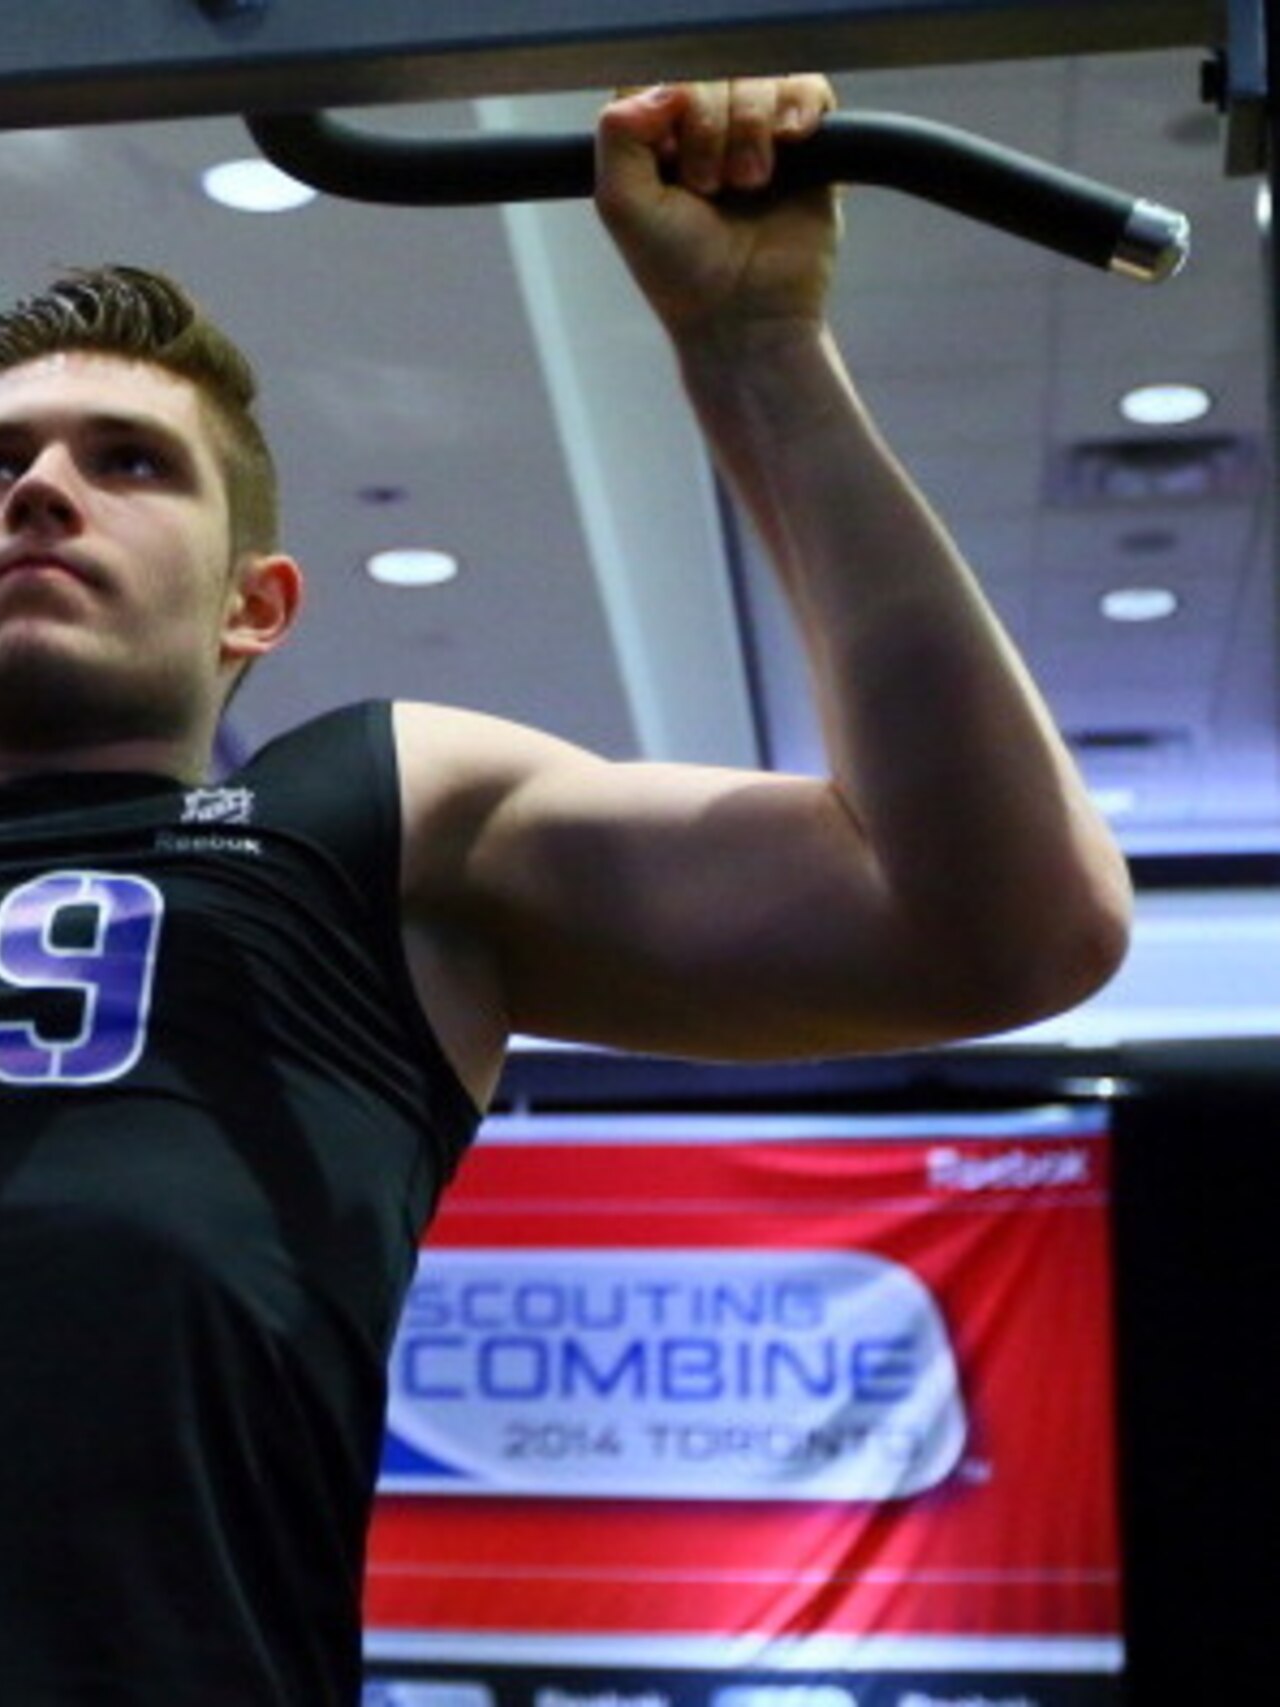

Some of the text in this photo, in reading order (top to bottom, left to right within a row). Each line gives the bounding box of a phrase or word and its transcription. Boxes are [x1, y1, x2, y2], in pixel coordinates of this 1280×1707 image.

[408, 1280, 828, 1330] SCOUTING
[402, 1336, 916, 1402] COMBINE
[503, 1422, 622, 1461] 2014
